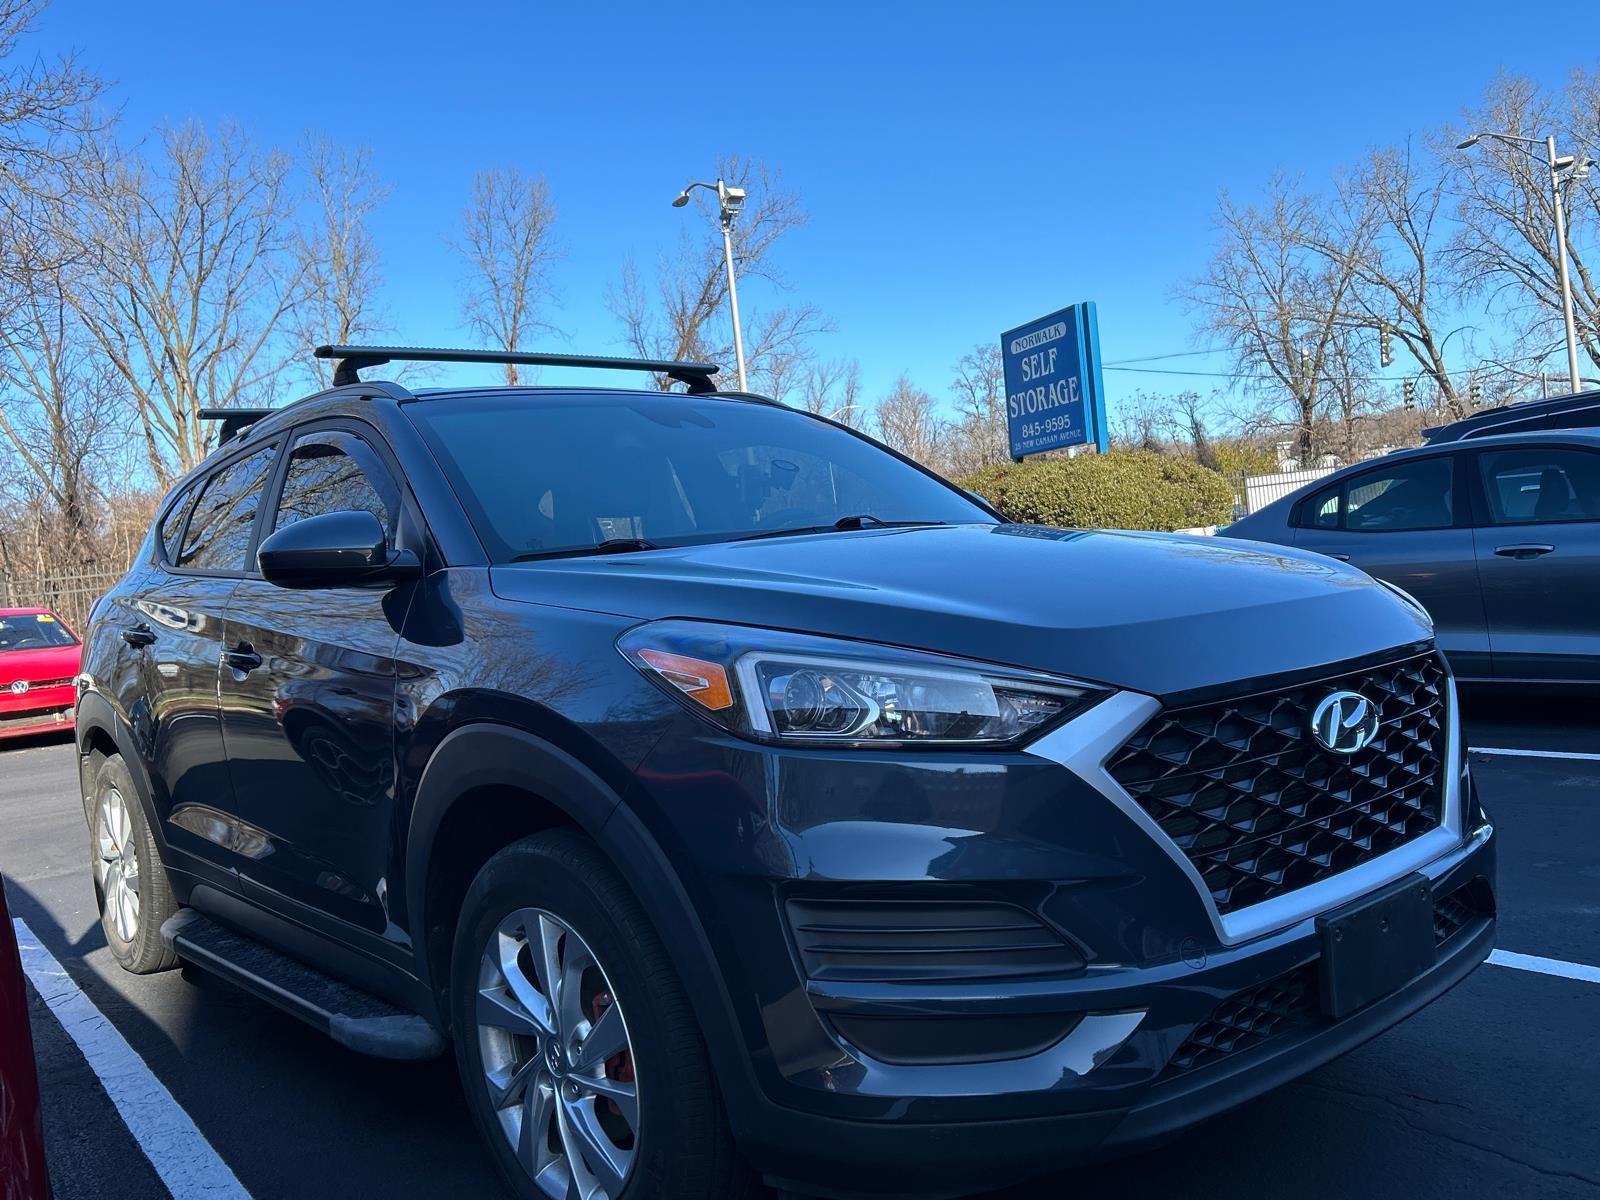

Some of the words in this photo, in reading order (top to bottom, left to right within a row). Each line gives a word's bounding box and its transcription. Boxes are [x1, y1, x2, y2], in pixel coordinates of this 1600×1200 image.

[1015, 324, 1061, 352] NORWALK
[1022, 347, 1057, 382] SELF
[1010, 376, 1080, 418] STORAGE
[1022, 415, 1071, 438] 845-9595
[1022, 440, 1034, 449] NEW
[1060, 429, 1082, 441] AVENUE
